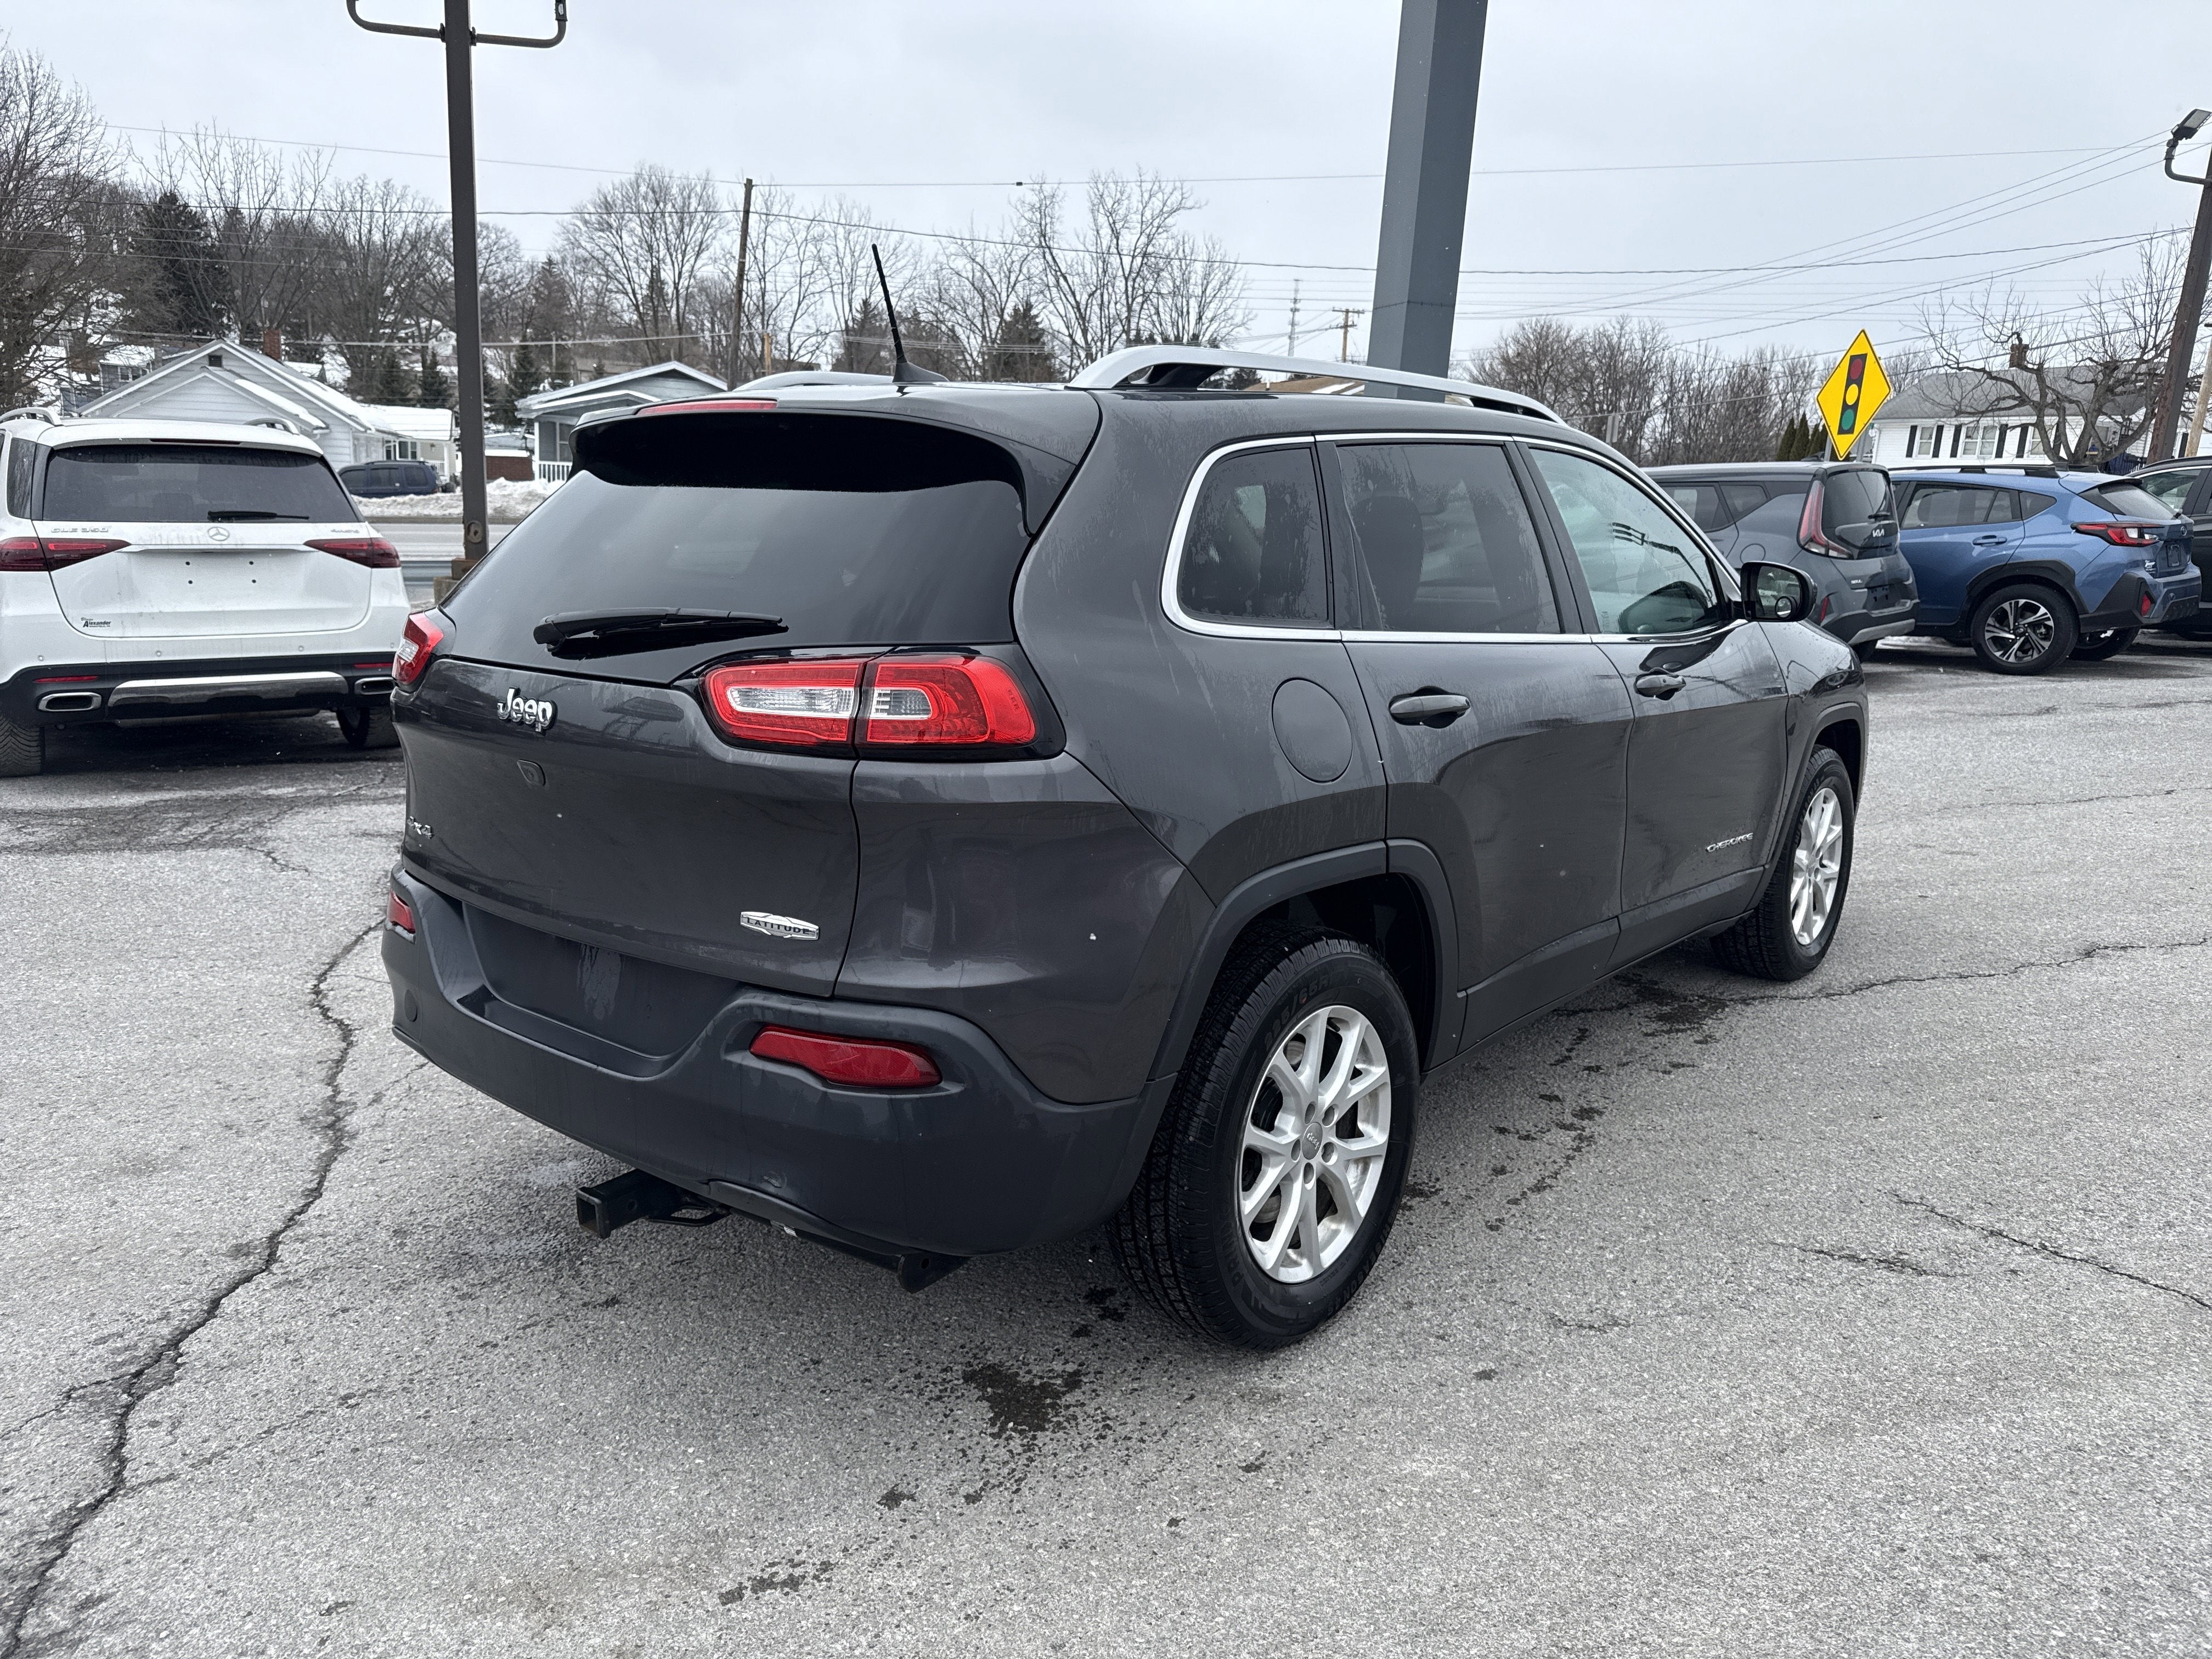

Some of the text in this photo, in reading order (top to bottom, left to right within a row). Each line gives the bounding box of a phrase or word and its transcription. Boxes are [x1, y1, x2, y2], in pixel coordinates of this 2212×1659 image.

[496, 687, 554, 732] Jeep
[1706, 832, 1754, 853] CHEROKEE
[746, 917, 811, 935] LATITUDE
